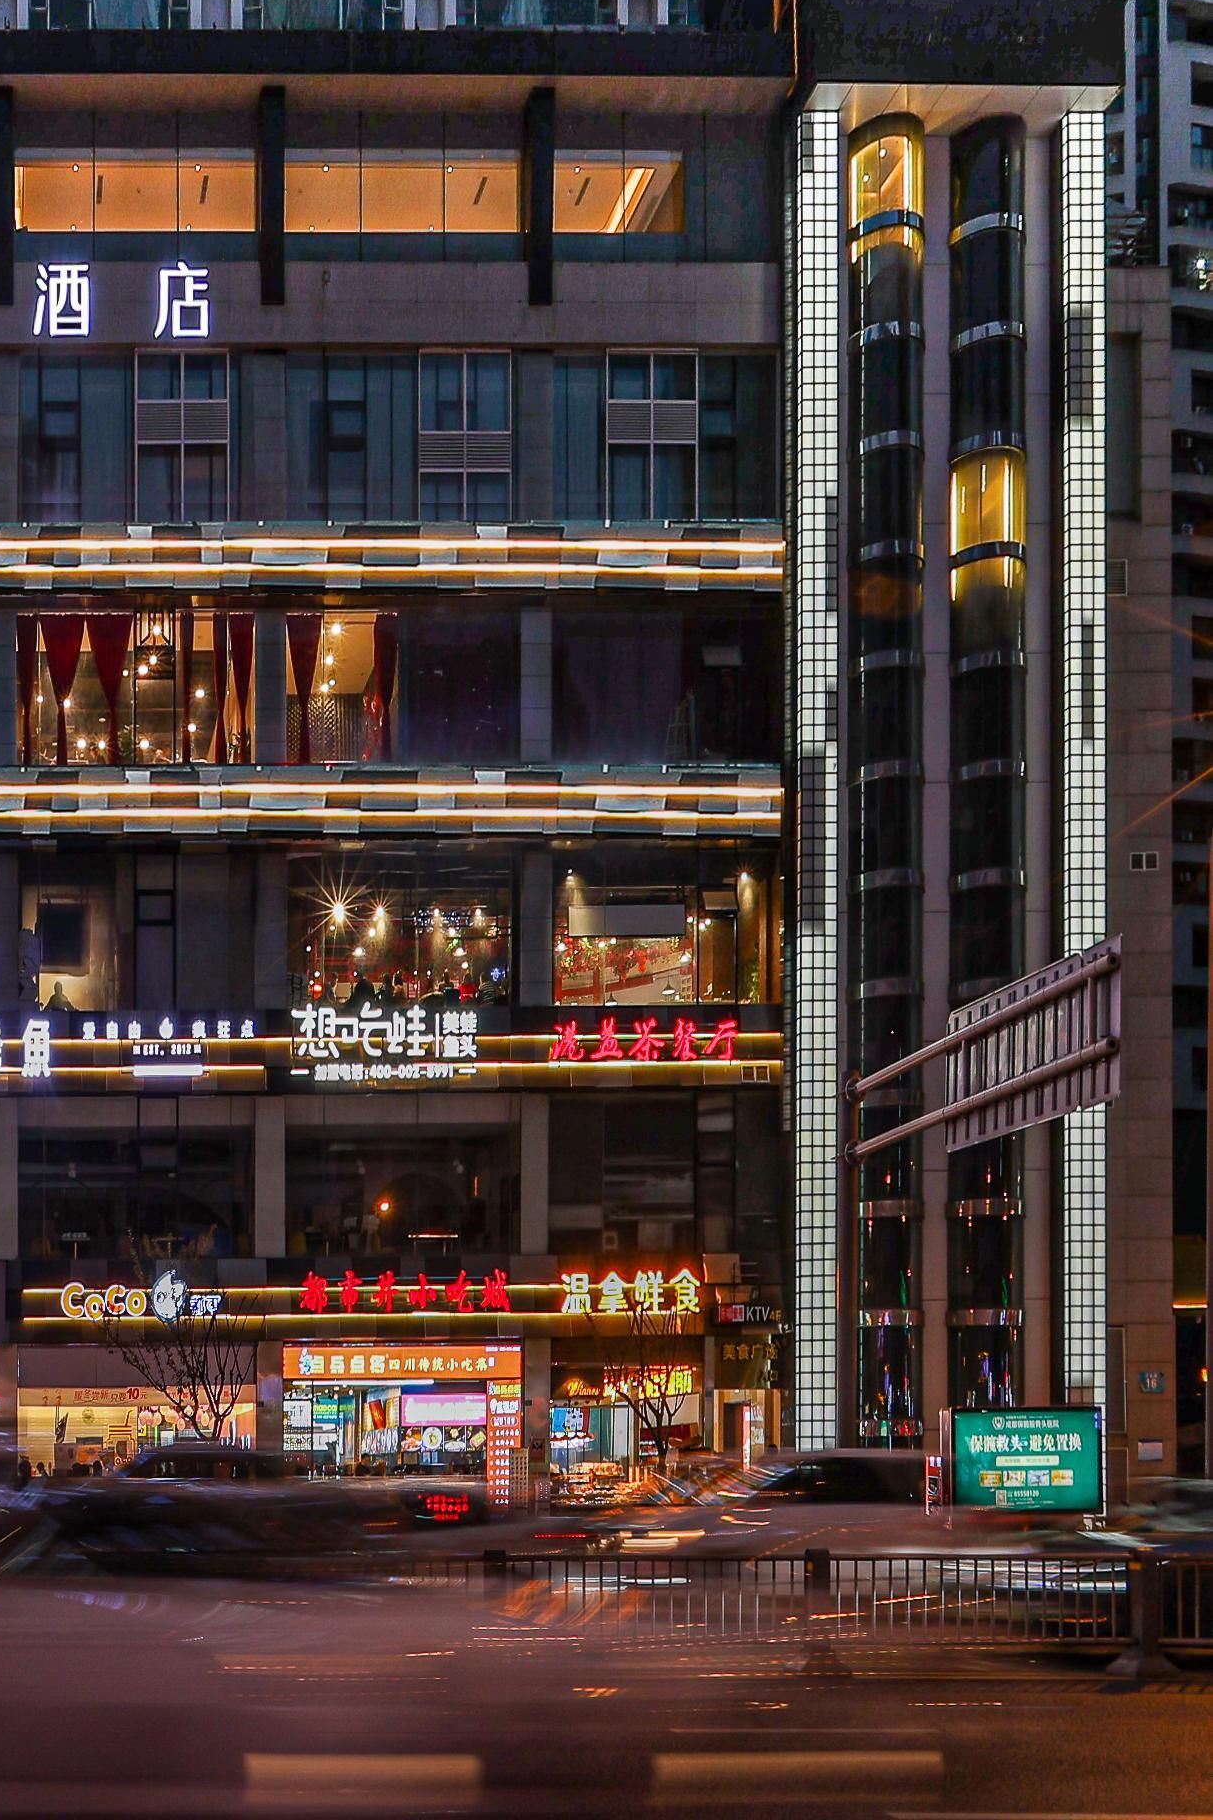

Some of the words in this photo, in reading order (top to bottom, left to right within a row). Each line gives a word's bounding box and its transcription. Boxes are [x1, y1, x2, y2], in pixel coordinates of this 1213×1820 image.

[291, 1001, 434, 1059] 想吃蛙
[61, 1282, 147, 1321] CoCo
[561, 1268, 702, 1315] 温拿鲜食
[746, 1305, 770, 1322] KTV
